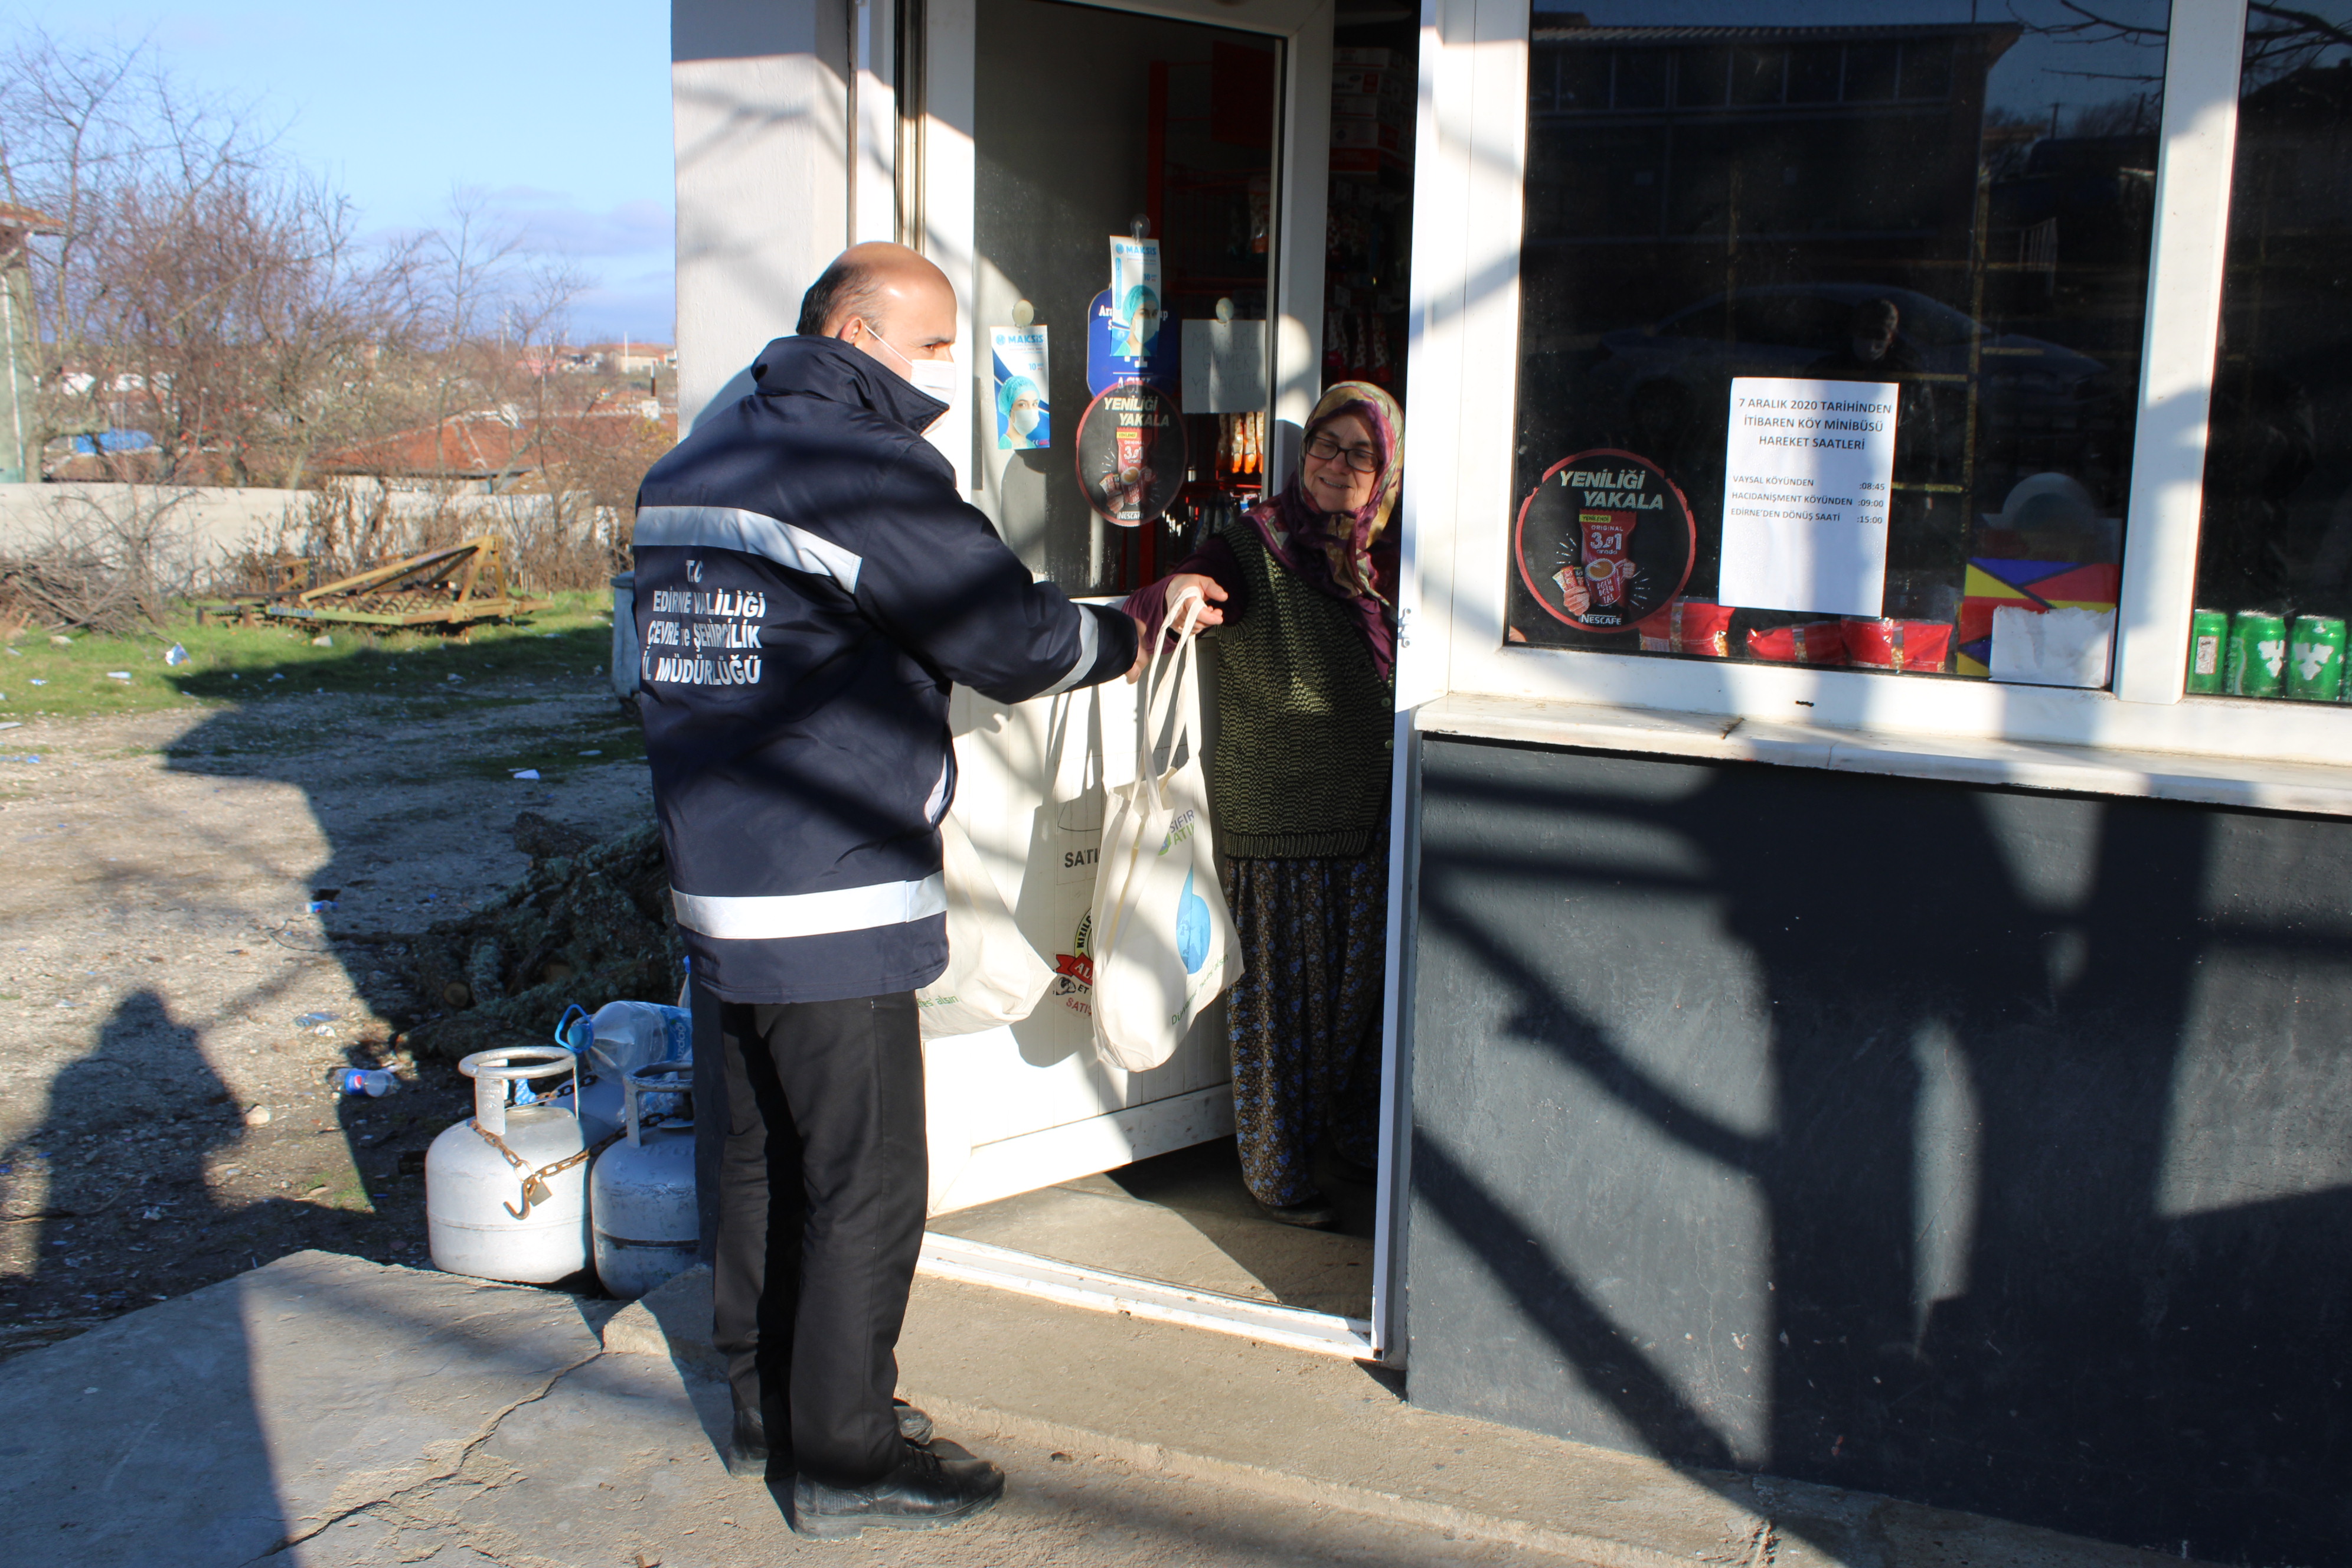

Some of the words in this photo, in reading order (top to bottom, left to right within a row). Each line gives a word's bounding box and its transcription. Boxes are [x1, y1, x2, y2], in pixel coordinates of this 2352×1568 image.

[1104, 396, 1158, 411] YENİLİĞİ
[1739, 398, 1745, 407] 7
[1748, 398, 1788, 409] ARALIK
[1791, 400, 1818, 410] 2020
[1820, 400, 1892, 414] TARİHİNDEN
[1119, 413, 1170, 426] YAKALA
[1744, 414, 1794, 427] İTİBAREN
[1798, 417, 1821, 429] KÖY
[1824, 418, 1883, 432] MİNİBÜSÜ
[1759, 436, 1809, 447] HAREKET
[1812, 437, 1865, 450] SAATLERİ
[1560, 469, 1645, 489] YENİLİĞİ
[1733, 475, 1763, 484] VAYSAL
[1766, 476, 1814, 486] KÖYÜNDEN
[1859, 482, 1885, 491] :08:45
[1584, 491, 1664, 510] YAKALA
[1732, 492, 1802, 502] HACIDANİŞMENT
[1804, 496, 1853, 506] KÖYÜNDEN
[1782, 511, 1813, 522] DÖNÜŞ
[1815, 513, 1840, 521] SAATİ
[653, 586, 692, 613] EDİRNE
[693, 588, 766, 618] VALİLİĞİ
[646, 620, 680, 649] ÇEVRE
[693, 618, 762, 652] ŞEHİRCİLİK
[654, 653, 762, 685] MÜDÜRLÜĞÜ
[1064, 848, 1100, 868] SATI
[1077, 984, 1089, 995] ET
